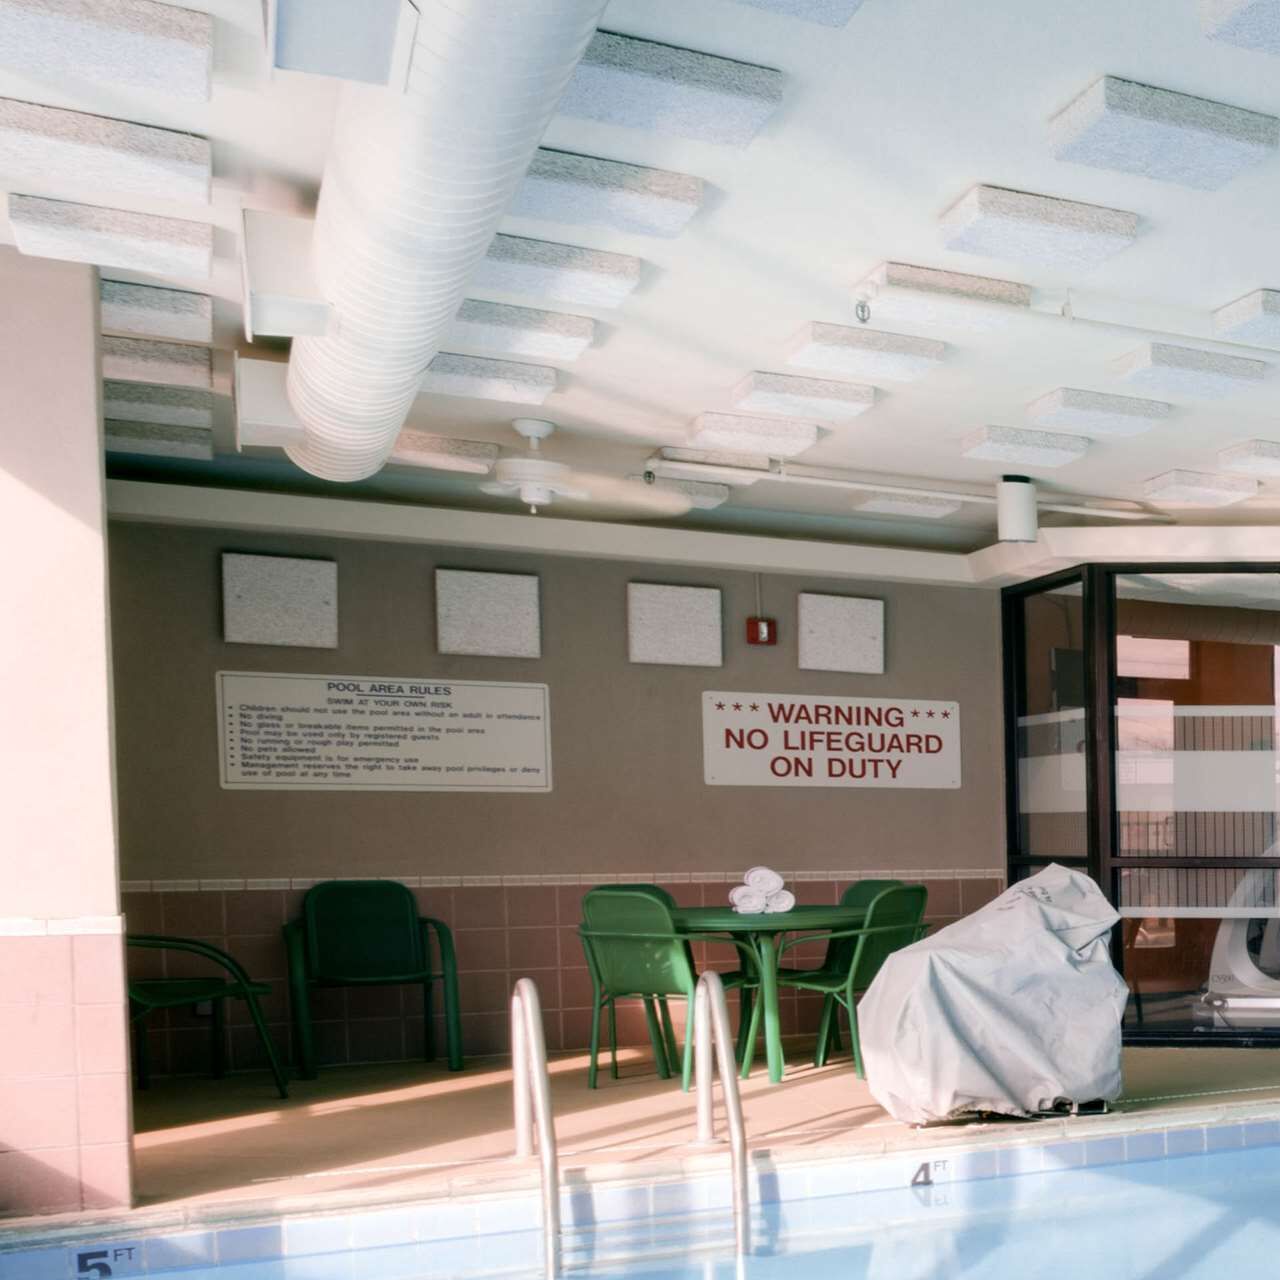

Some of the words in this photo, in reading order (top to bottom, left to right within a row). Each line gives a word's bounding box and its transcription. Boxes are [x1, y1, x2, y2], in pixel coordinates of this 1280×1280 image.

[327, 682, 364, 692] POOL
[369, 684, 405, 693] AREA
[409, 685, 452, 695] RULES
[356, 698, 370, 706] AT
[373, 699, 400, 707] YOUR
[403, 700, 427, 708] OWN
[239, 704, 276, 712] Children
[496, 712, 540, 720] attendance
[256, 713, 283, 722] diving
[768, 703, 904, 727] WARNING
[373, 724, 414, 733] permitted
[256, 737, 290, 746] running
[357, 740, 399, 749] permitted
[364, 732, 407, 741] registered
[411, 733, 438, 742] guests
[724, 728, 768, 750] NO
[784, 731, 942, 754] LIFEGUARD
[241, 753, 270, 762] Safety
[274, 754, 320, 763] equipment
[353, 756, 400, 764] emergency
[240, 762, 299, 771] Management
[466, 765, 506, 774] privileges
[770, 756, 812, 777] ON
[828, 758, 902, 778] DUTY
[911, 1162, 934, 1186] 4
[934, 1160, 948, 1170] FT
[78, 1250, 112, 1280] 5
[114, 1247, 135, 1261] FT
